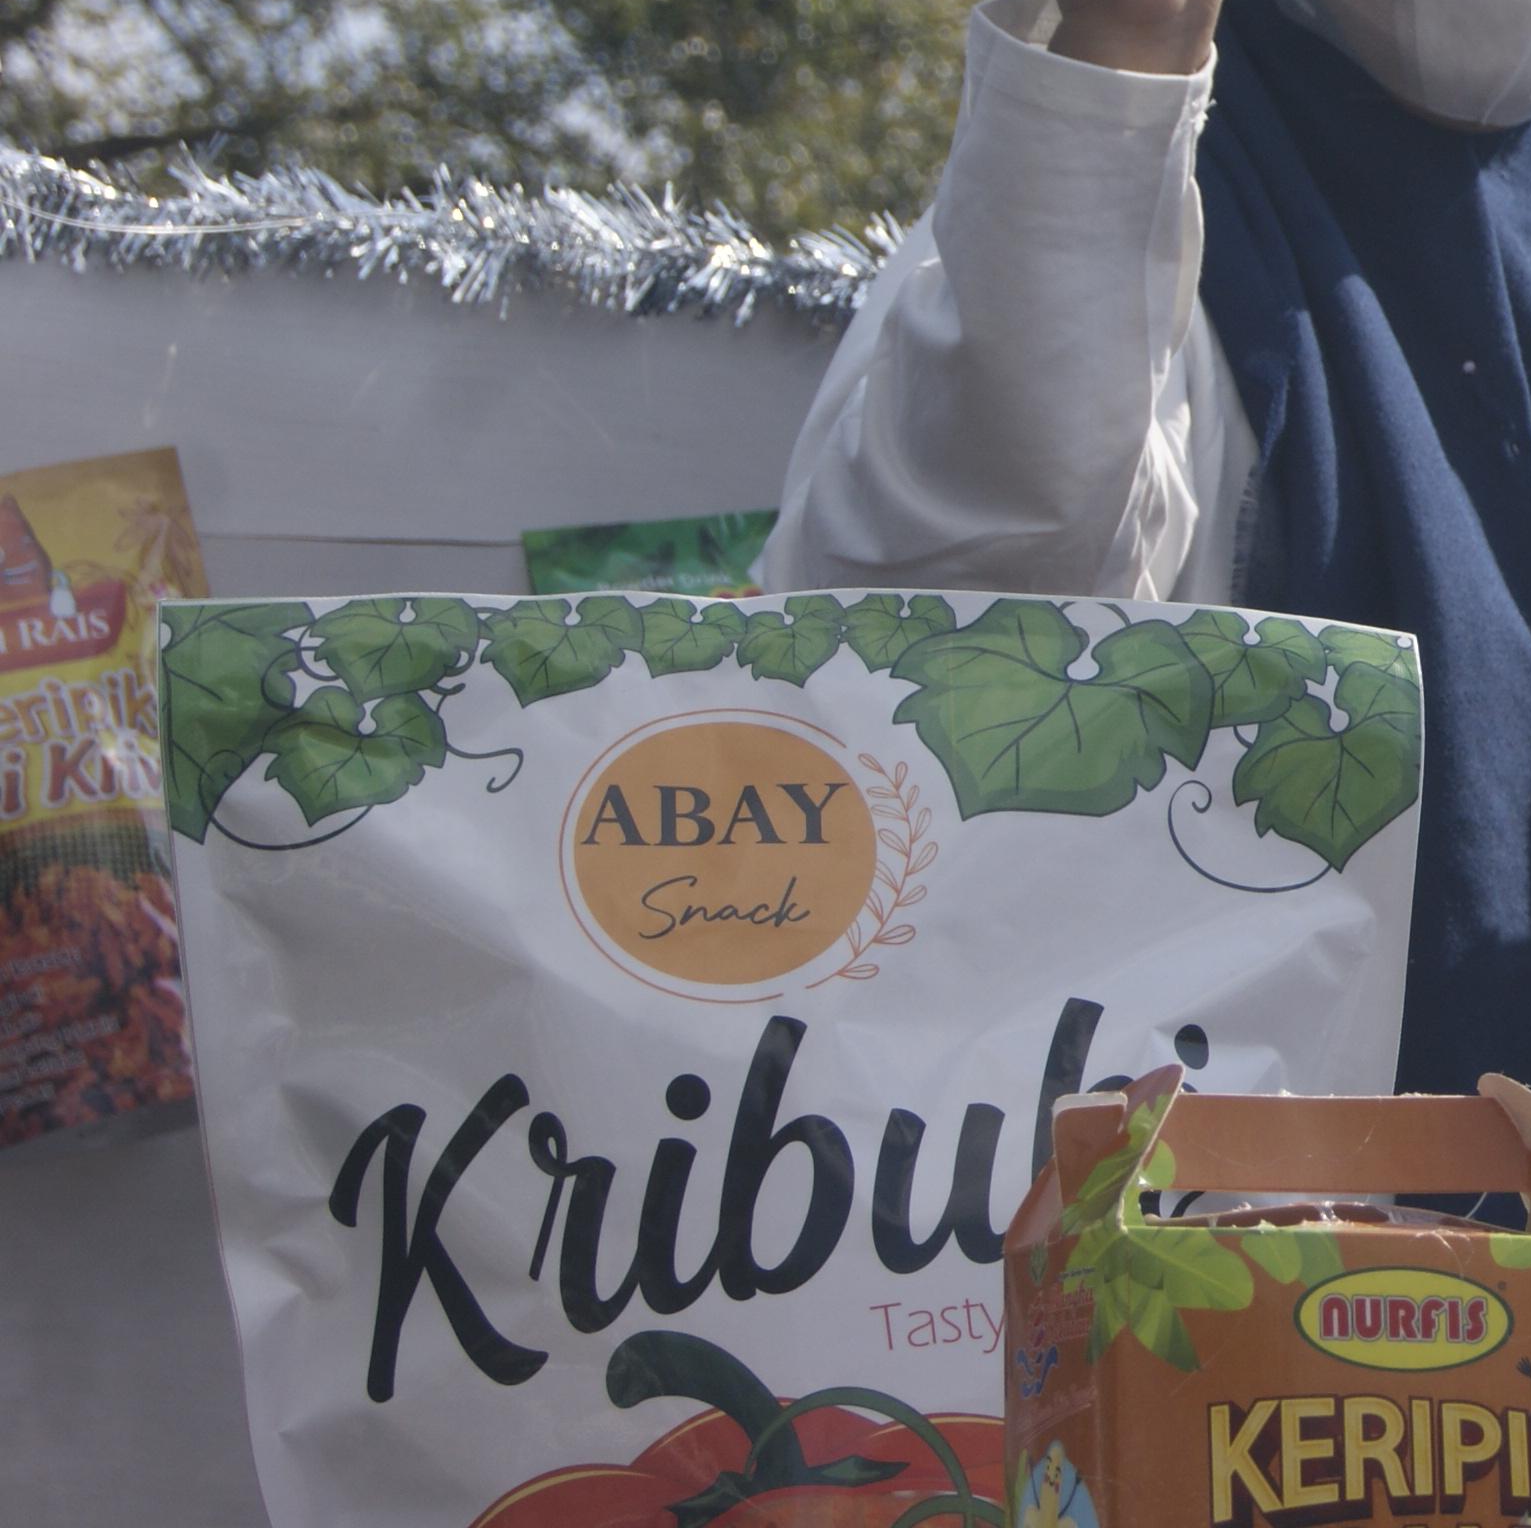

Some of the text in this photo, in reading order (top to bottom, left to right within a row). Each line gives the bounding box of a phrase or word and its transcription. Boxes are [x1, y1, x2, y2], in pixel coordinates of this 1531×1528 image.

[0, 672, 158, 740] eripik
[581, 783, 849, 847] ABAY
[638, 875, 811, 940] Snack
[869, 1298, 1005, 1354] Tasty
[1320, 1293, 1488, 1344] NURFIS
